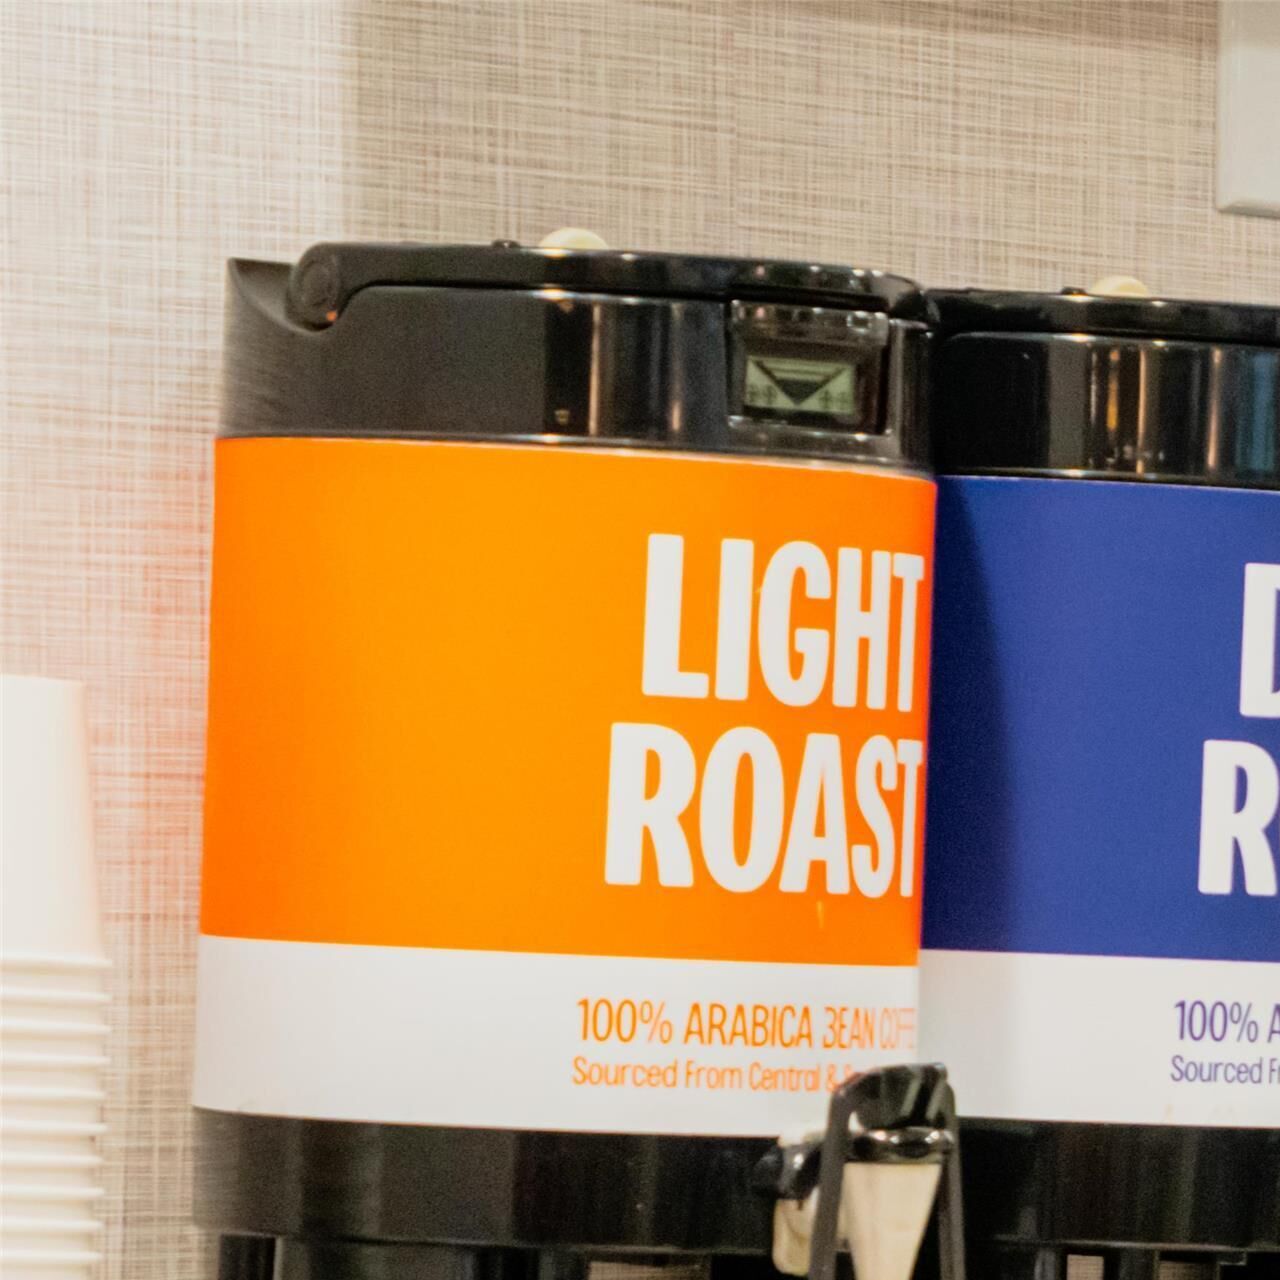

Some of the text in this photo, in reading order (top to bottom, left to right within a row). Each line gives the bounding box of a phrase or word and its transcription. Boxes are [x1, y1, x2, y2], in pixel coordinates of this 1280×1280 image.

[641, 533, 924, 713] LIGHT
[604, 721, 923, 899] ROAST
[577, 998, 673, 1043] 100%
[683, 1001, 813, 1049] ARABICA
[1174, 999, 1260, 1043] 100%
[572, 1055, 679, 1088] Sourced
[684, 1060, 742, 1090] From
[750, 1061, 820, 1093] Central
[1170, 1054, 1263, 1084] Sourced
